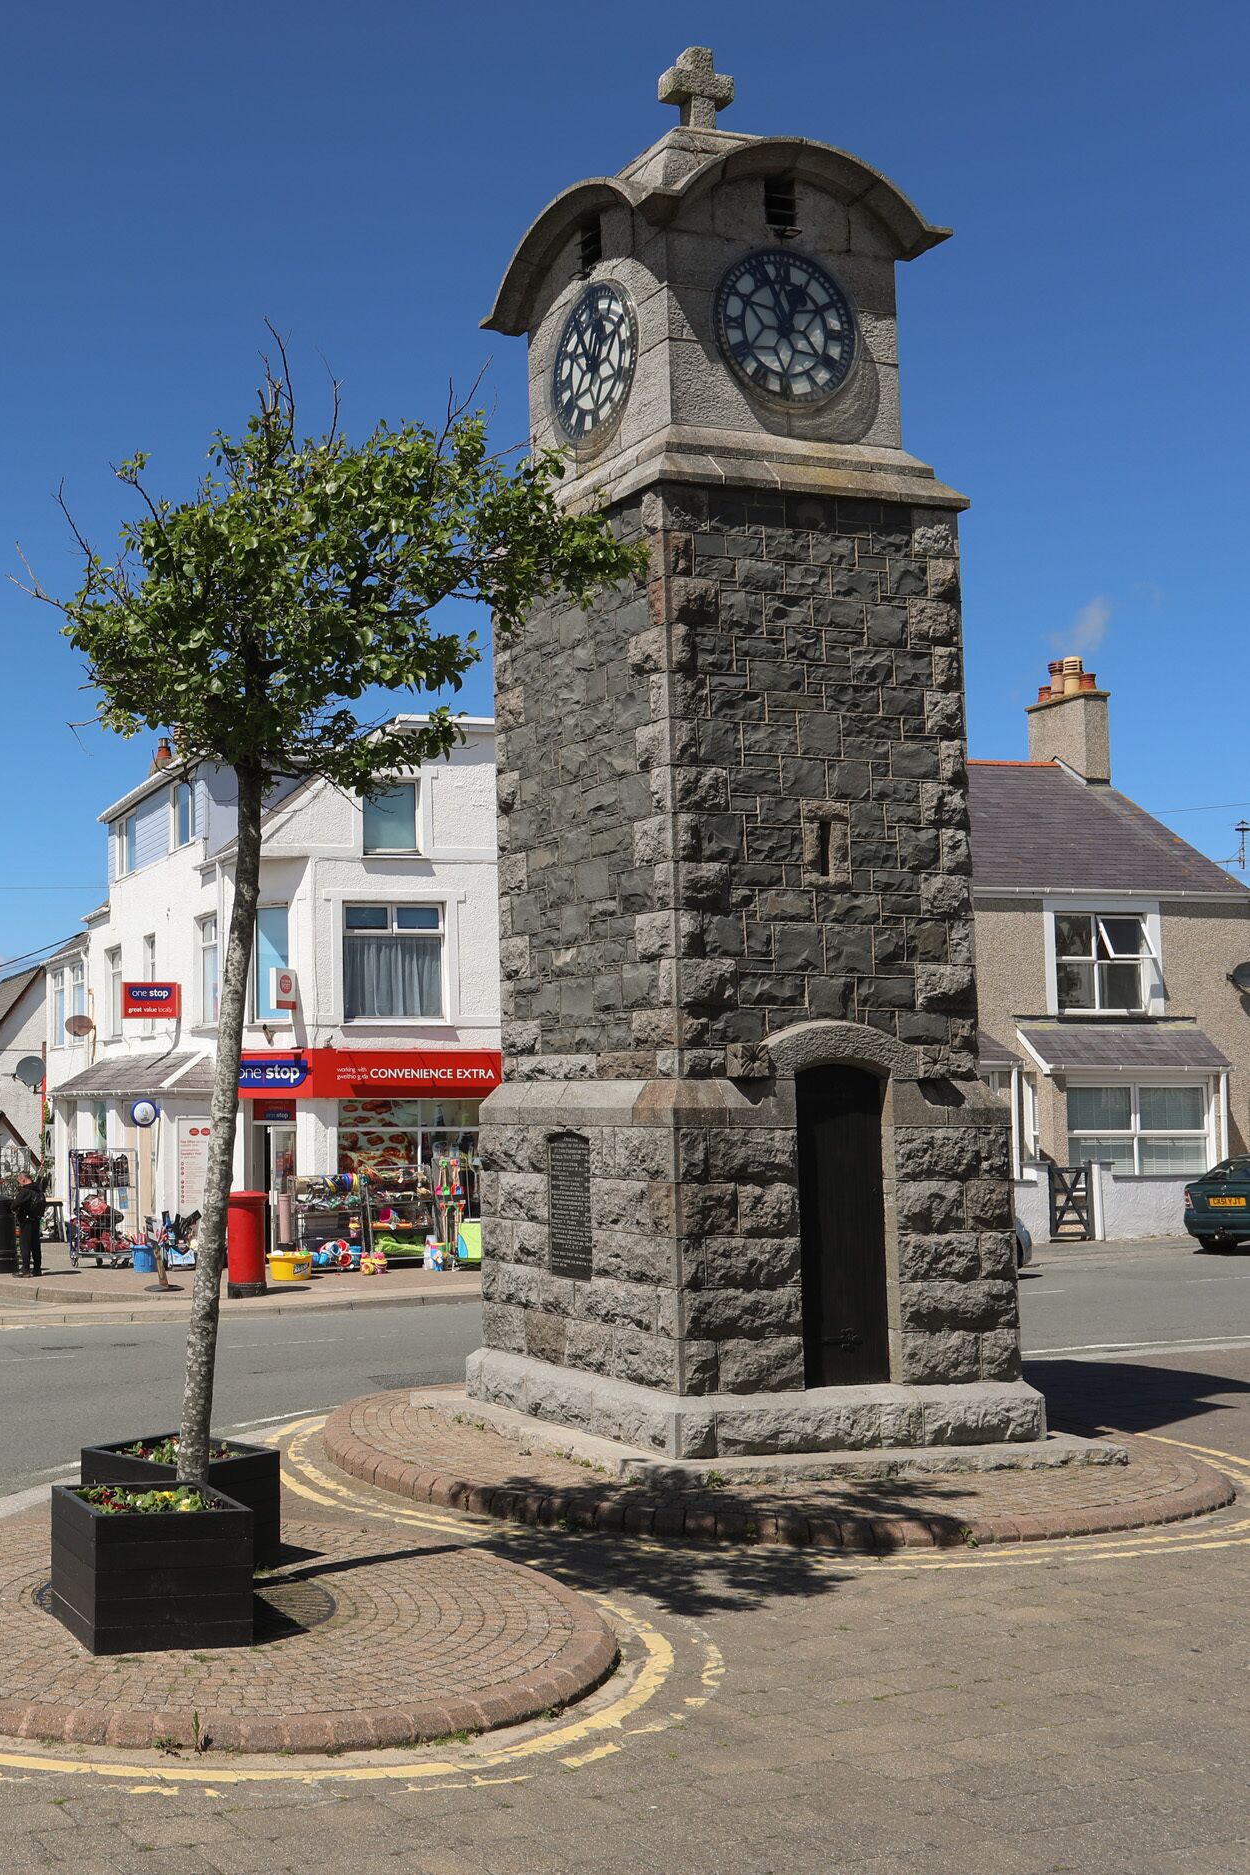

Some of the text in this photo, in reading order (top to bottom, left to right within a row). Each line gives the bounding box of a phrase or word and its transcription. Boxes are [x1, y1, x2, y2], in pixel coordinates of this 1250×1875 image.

[131, 988, 170, 1000] one stop
[128, 1006, 143, 1014] great
[158, 1006, 174, 1014] locally
[239, 1063, 301, 1084] one stop
[336, 1066, 356, 1074] working
[369, 1068, 495, 1079] CONVENIENCE EXTRA
